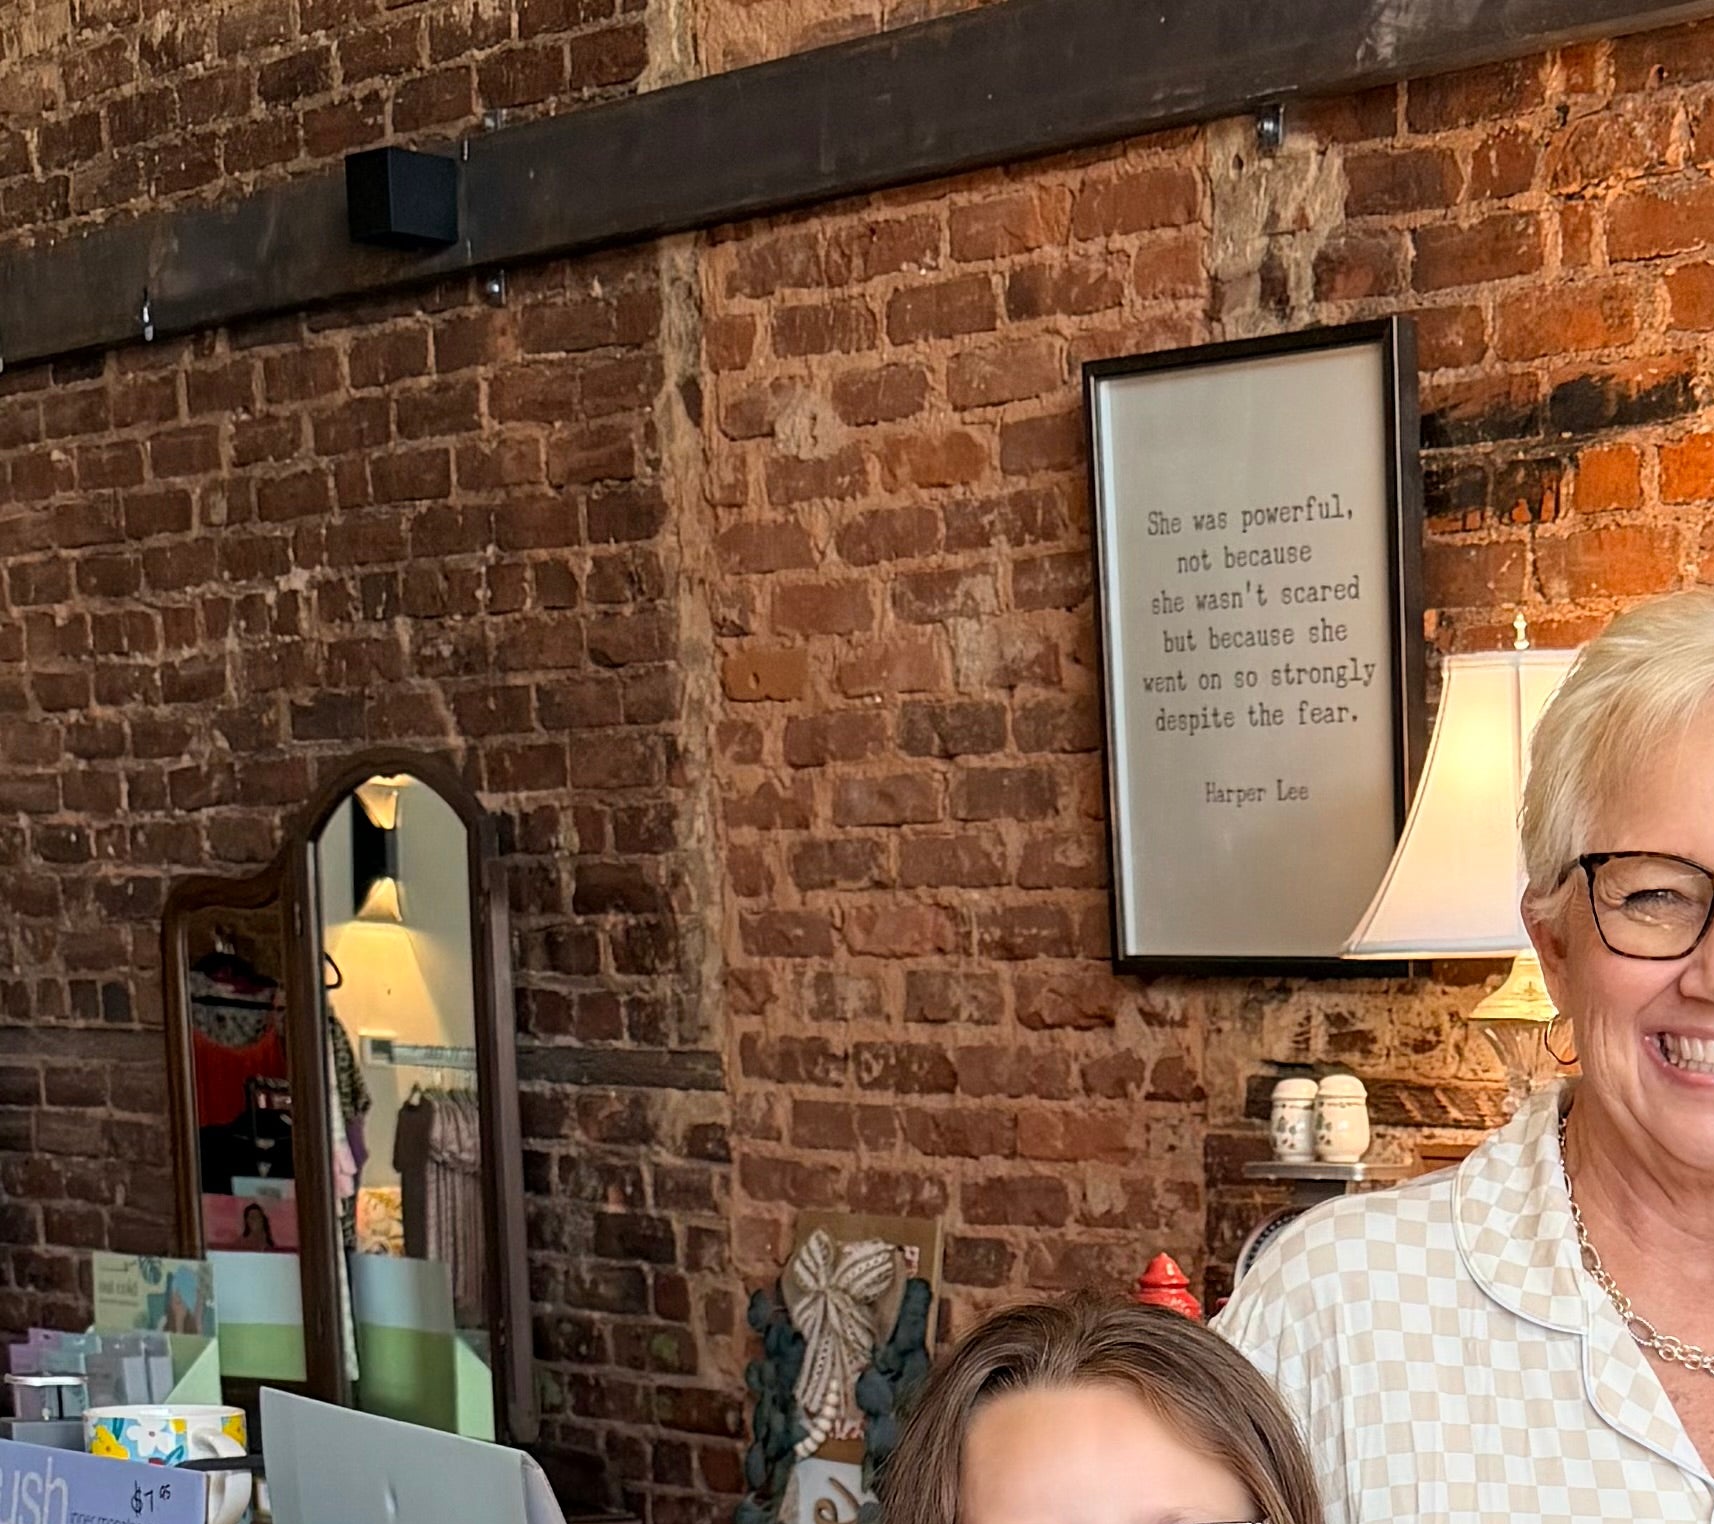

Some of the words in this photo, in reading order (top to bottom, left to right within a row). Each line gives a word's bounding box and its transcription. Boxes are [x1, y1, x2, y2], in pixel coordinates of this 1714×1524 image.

[1147, 511, 1182, 536] She
[1194, 511, 1228, 531] was
[1241, 494, 1353, 533] powerful,
[1177, 549, 1212, 574] not
[1224, 545, 1312, 569] because
[1151, 590, 1185, 615] she
[1195, 580, 1268, 611] wasn't
[1281, 575, 1360, 605] scared
[1163, 630, 1197, 653] but
[1209, 627, 1295, 650] because
[1308, 617, 1348, 644] she
[1143, 670, 1187, 693] went
[1198, 674, 1223, 691] on
[1234, 670, 1258, 688] so
[1271, 657, 1376, 688] strongly
[1155, 708, 1235, 736] despite
[1248, 702, 1284, 727] the
[1298, 700, 1358, 725] fear.
[1205, 781, 1266, 807] Harper
[1276, 779, 1309, 800] Lee
